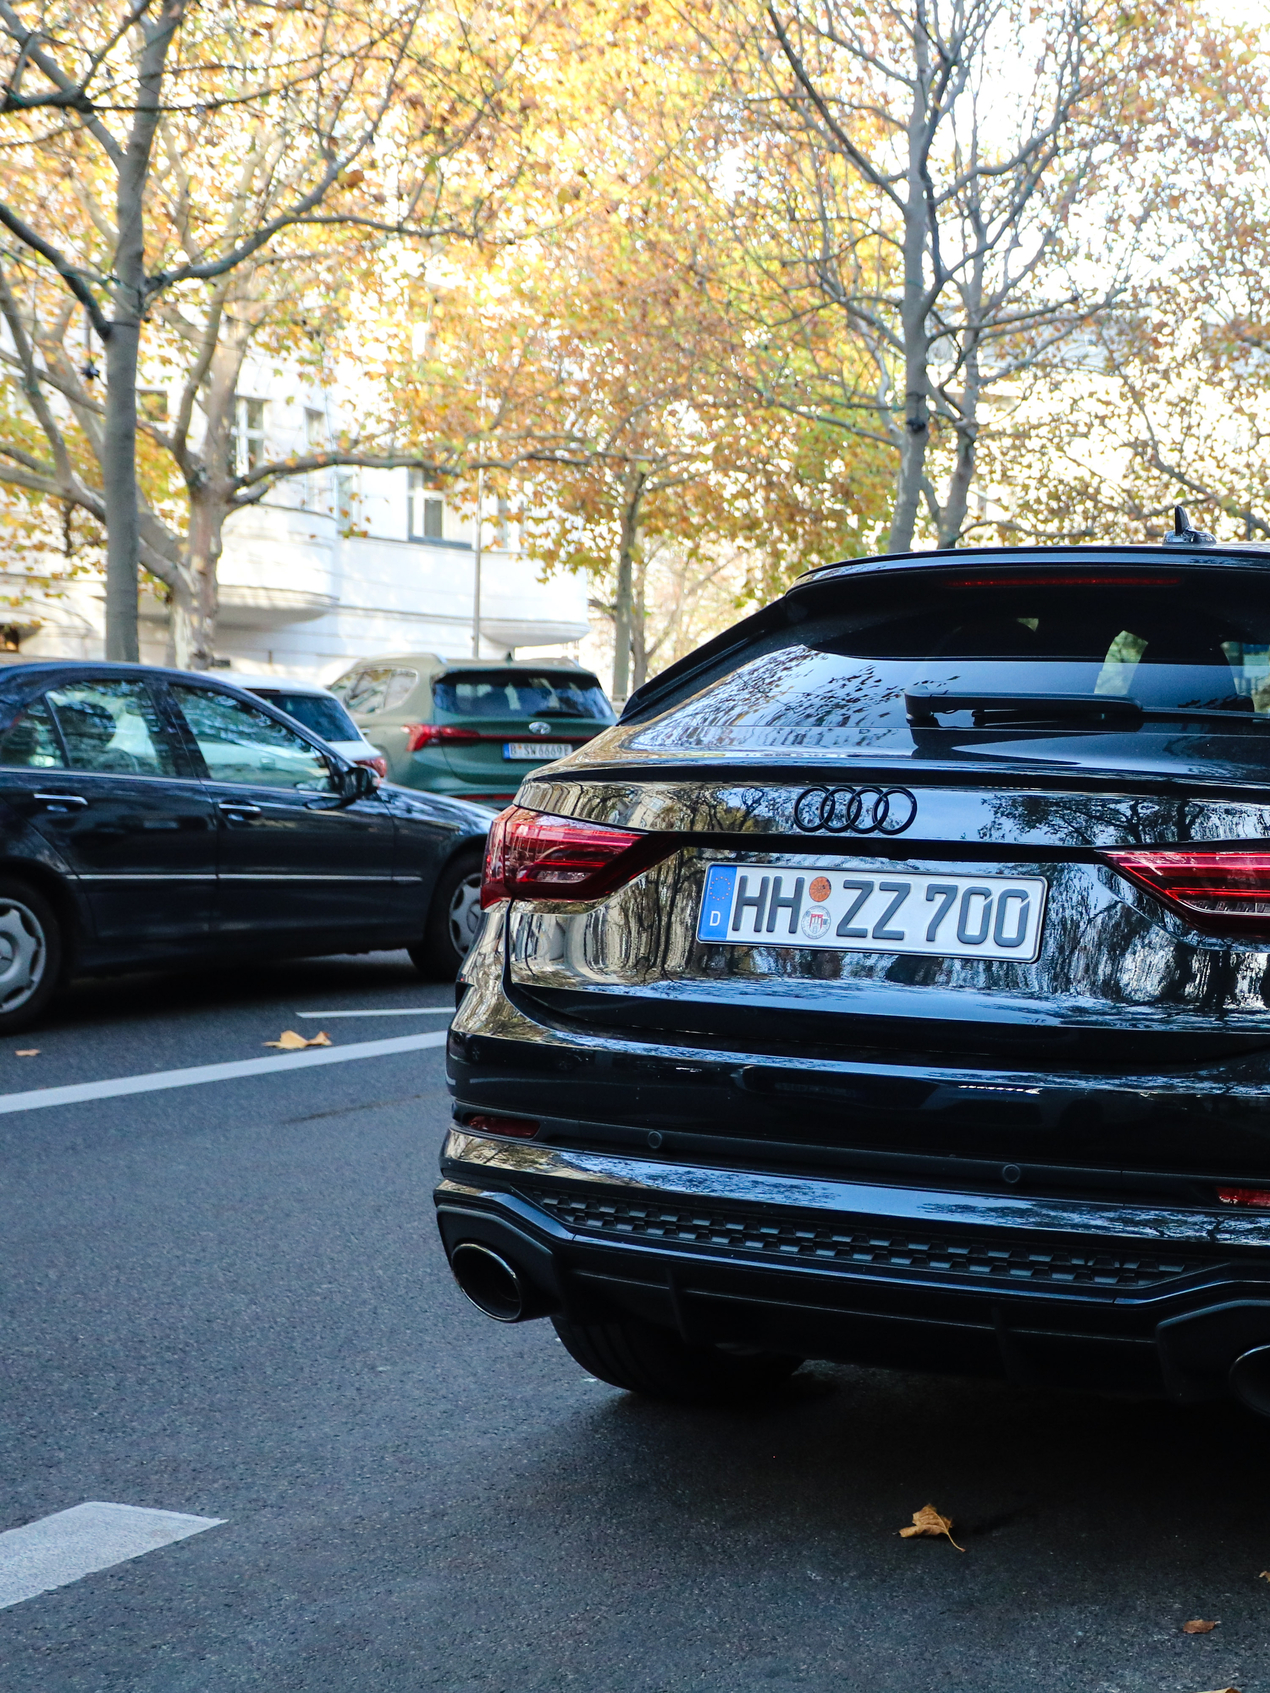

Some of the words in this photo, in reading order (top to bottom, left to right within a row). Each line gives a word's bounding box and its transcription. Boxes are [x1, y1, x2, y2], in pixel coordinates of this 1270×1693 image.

[709, 910, 721, 927] D
[732, 875, 805, 934] HH
[836, 879, 911, 941] ZZ
[925, 884, 1031, 948] 700
